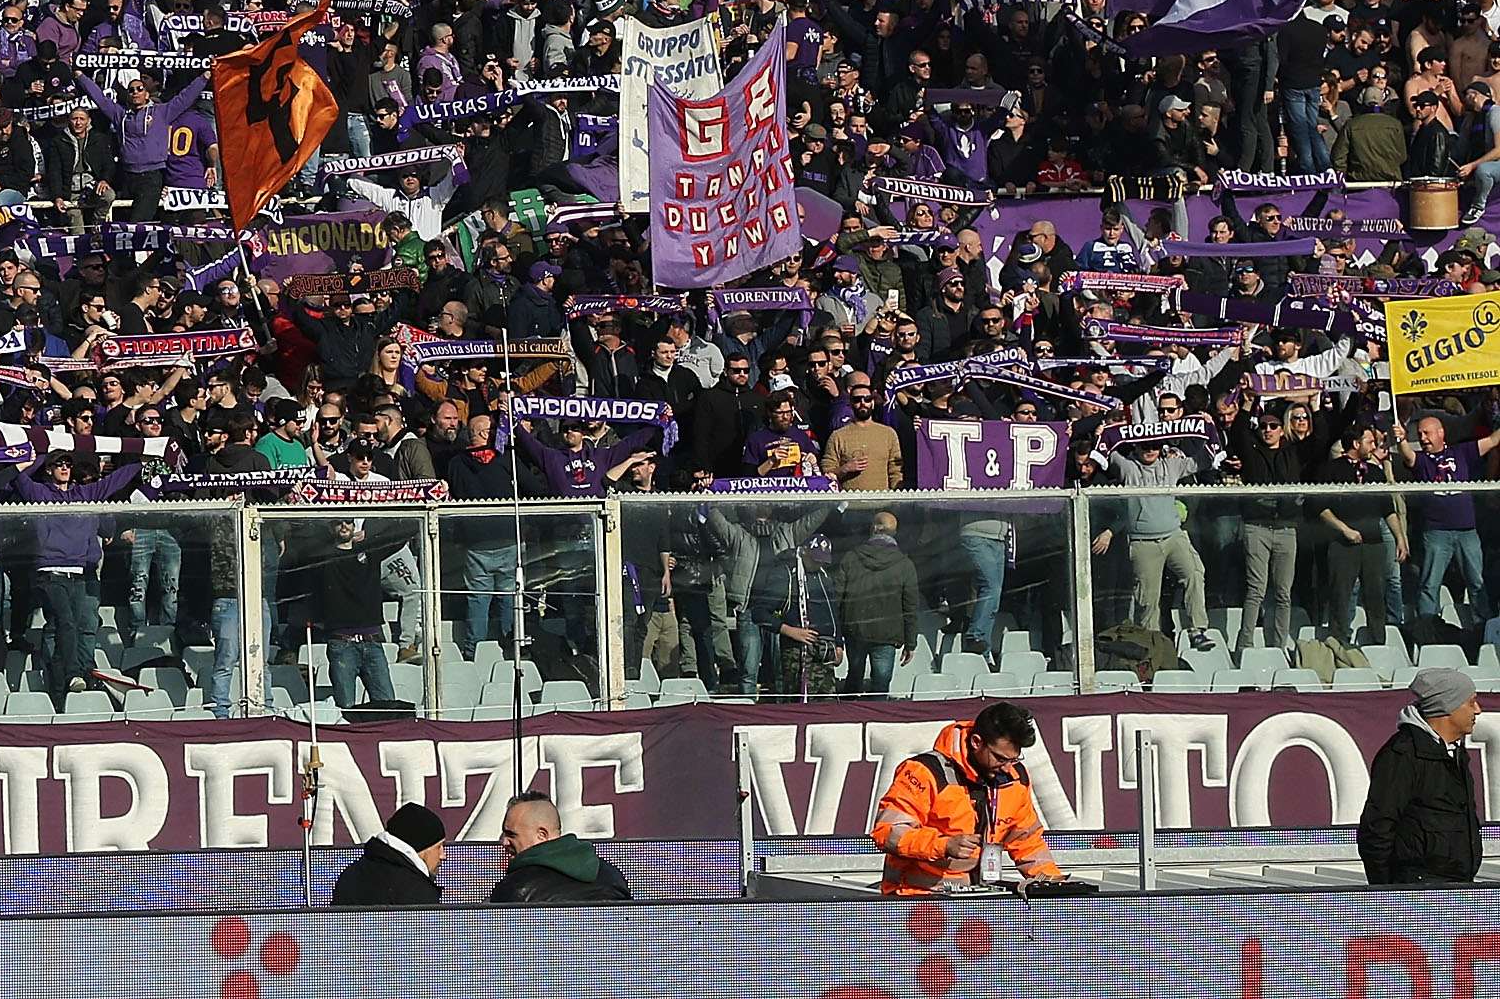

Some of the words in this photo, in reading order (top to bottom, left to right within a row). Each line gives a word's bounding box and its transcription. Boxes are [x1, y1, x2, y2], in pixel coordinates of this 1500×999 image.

[636, 27, 701, 59] GRUPPO
[75, 54, 141, 70] GRUPPO
[414, 95, 490, 120] ULTRAS
[494, 89, 516, 106] 73
[1223, 169, 1339, 190] FIORENTINA
[169, 191, 218, 209] JUVE
[884, 178, 976, 203] FIORENTINA
[722, 291, 802, 305] FIORENTINA
[119, 333, 239, 356] FIORENTINA
[431, 342, 464, 357] nostra
[465, 341, 496, 355] storia
[497, 341, 518, 354] nn
[1405, 325, 1487, 373] GIGIO
[1440, 372, 1465, 383] CURVA
[1466, 369, 1499, 381] FIESOLE
[513, 397, 660, 420] AFICIONADOS
[1119, 419, 1206, 440] FIORENTINA
[928, 420, 982, 491] T
[984, 448, 999, 476] &
[1009, 422, 1058, 491] P
[320, 486, 348, 501] ALE
[349, 487, 426, 502] FIORENTINA
[729, 477, 809, 490] FIORENTINA
[738, 711, 1367, 835] VNTO
